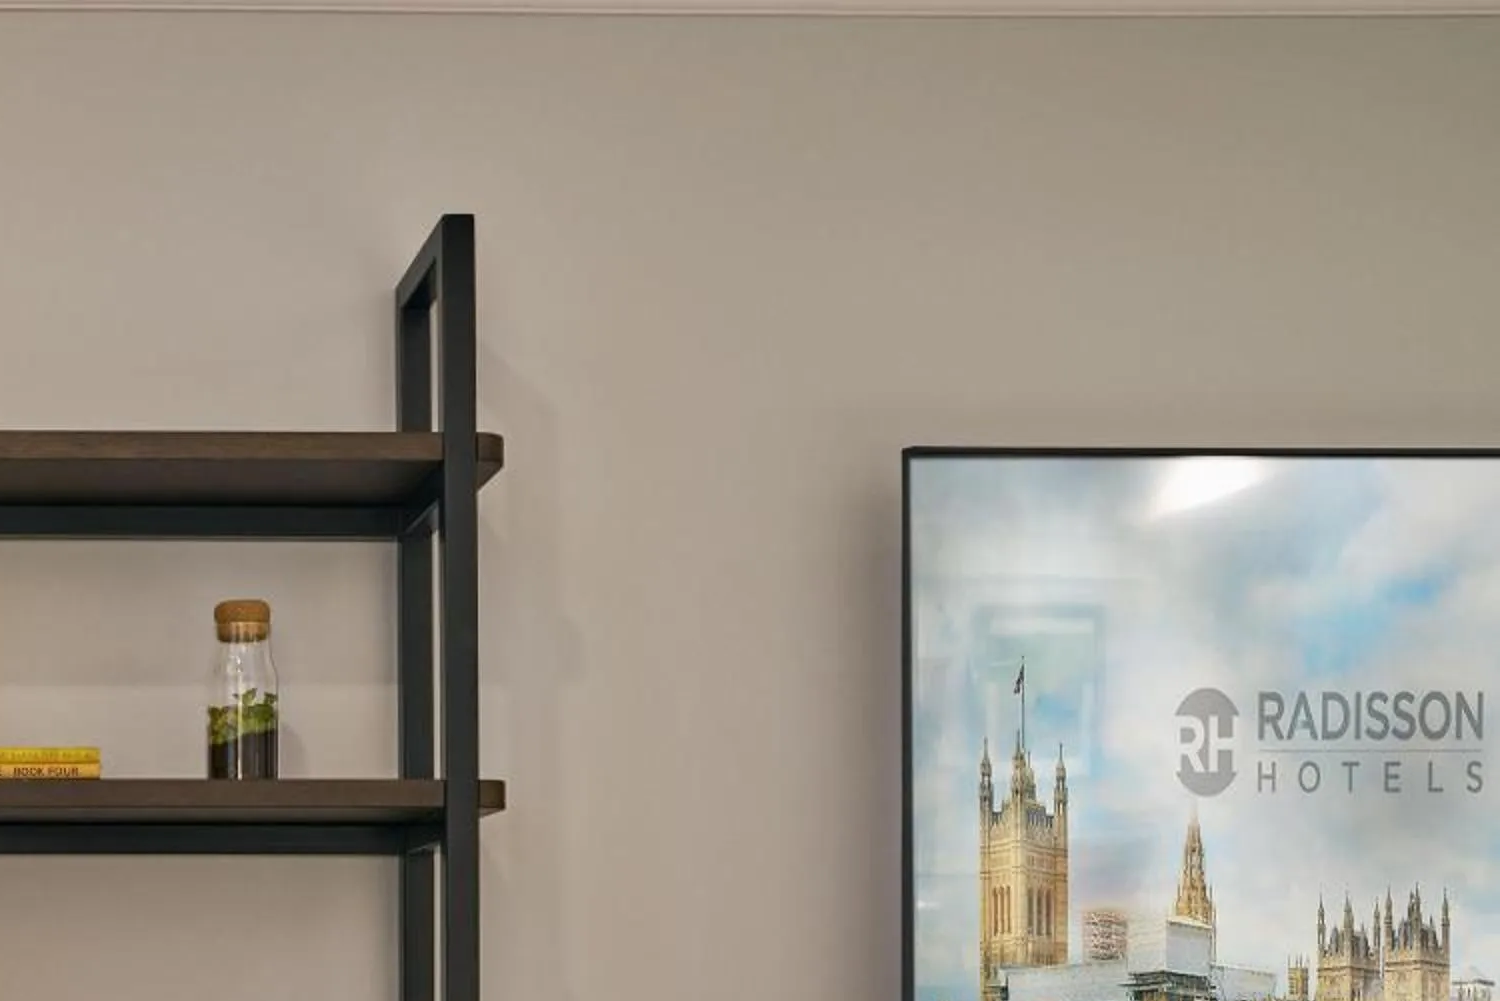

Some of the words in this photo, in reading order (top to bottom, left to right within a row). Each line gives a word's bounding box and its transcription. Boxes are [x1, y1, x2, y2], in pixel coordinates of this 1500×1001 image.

[1257, 691, 1484, 741] RADISSON
[13, 767, 45, 778] BOOK
[1257, 760, 1484, 794] HOTELS
